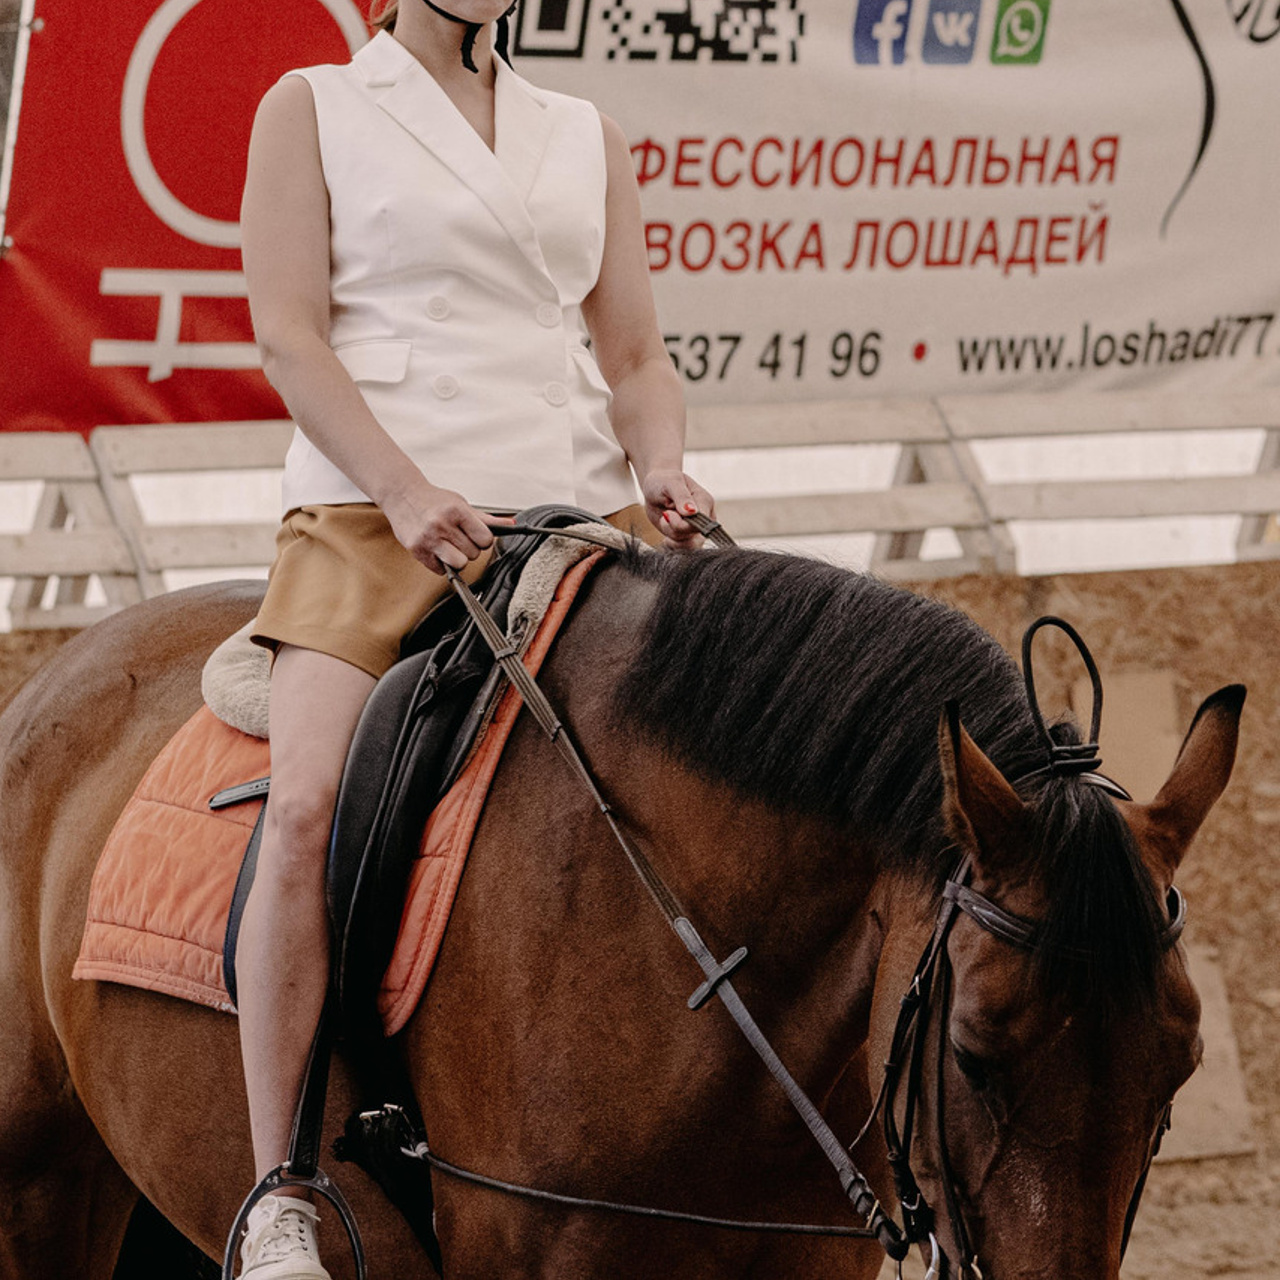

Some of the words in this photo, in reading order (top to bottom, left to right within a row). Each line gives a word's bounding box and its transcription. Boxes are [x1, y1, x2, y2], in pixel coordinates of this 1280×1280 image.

[843, 203, 1111, 274] ЛОШАДЕЙ
[758, 331, 807, 379] 41
[829, 331, 882, 378] 96
